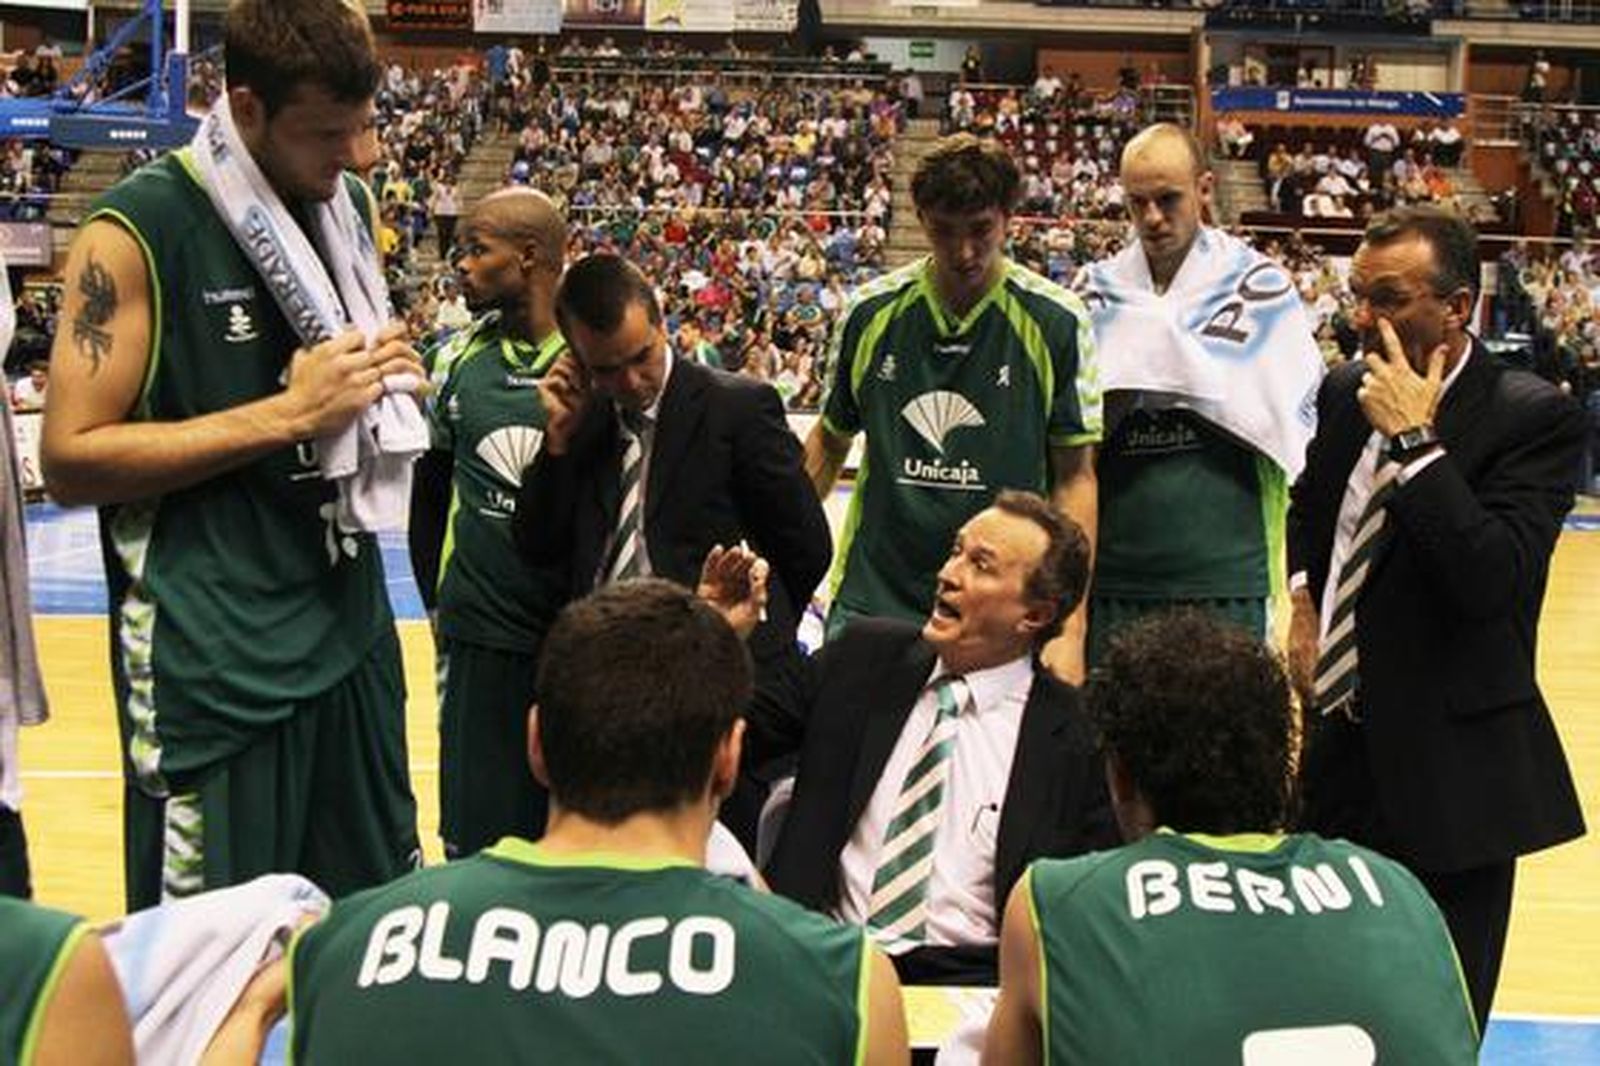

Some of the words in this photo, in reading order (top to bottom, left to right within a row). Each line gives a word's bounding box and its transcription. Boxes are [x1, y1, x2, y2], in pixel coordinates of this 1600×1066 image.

[904, 457, 980, 490] Unicaja
[1126, 855, 1384, 919] BERNI
[357, 900, 736, 999] BLANCO
